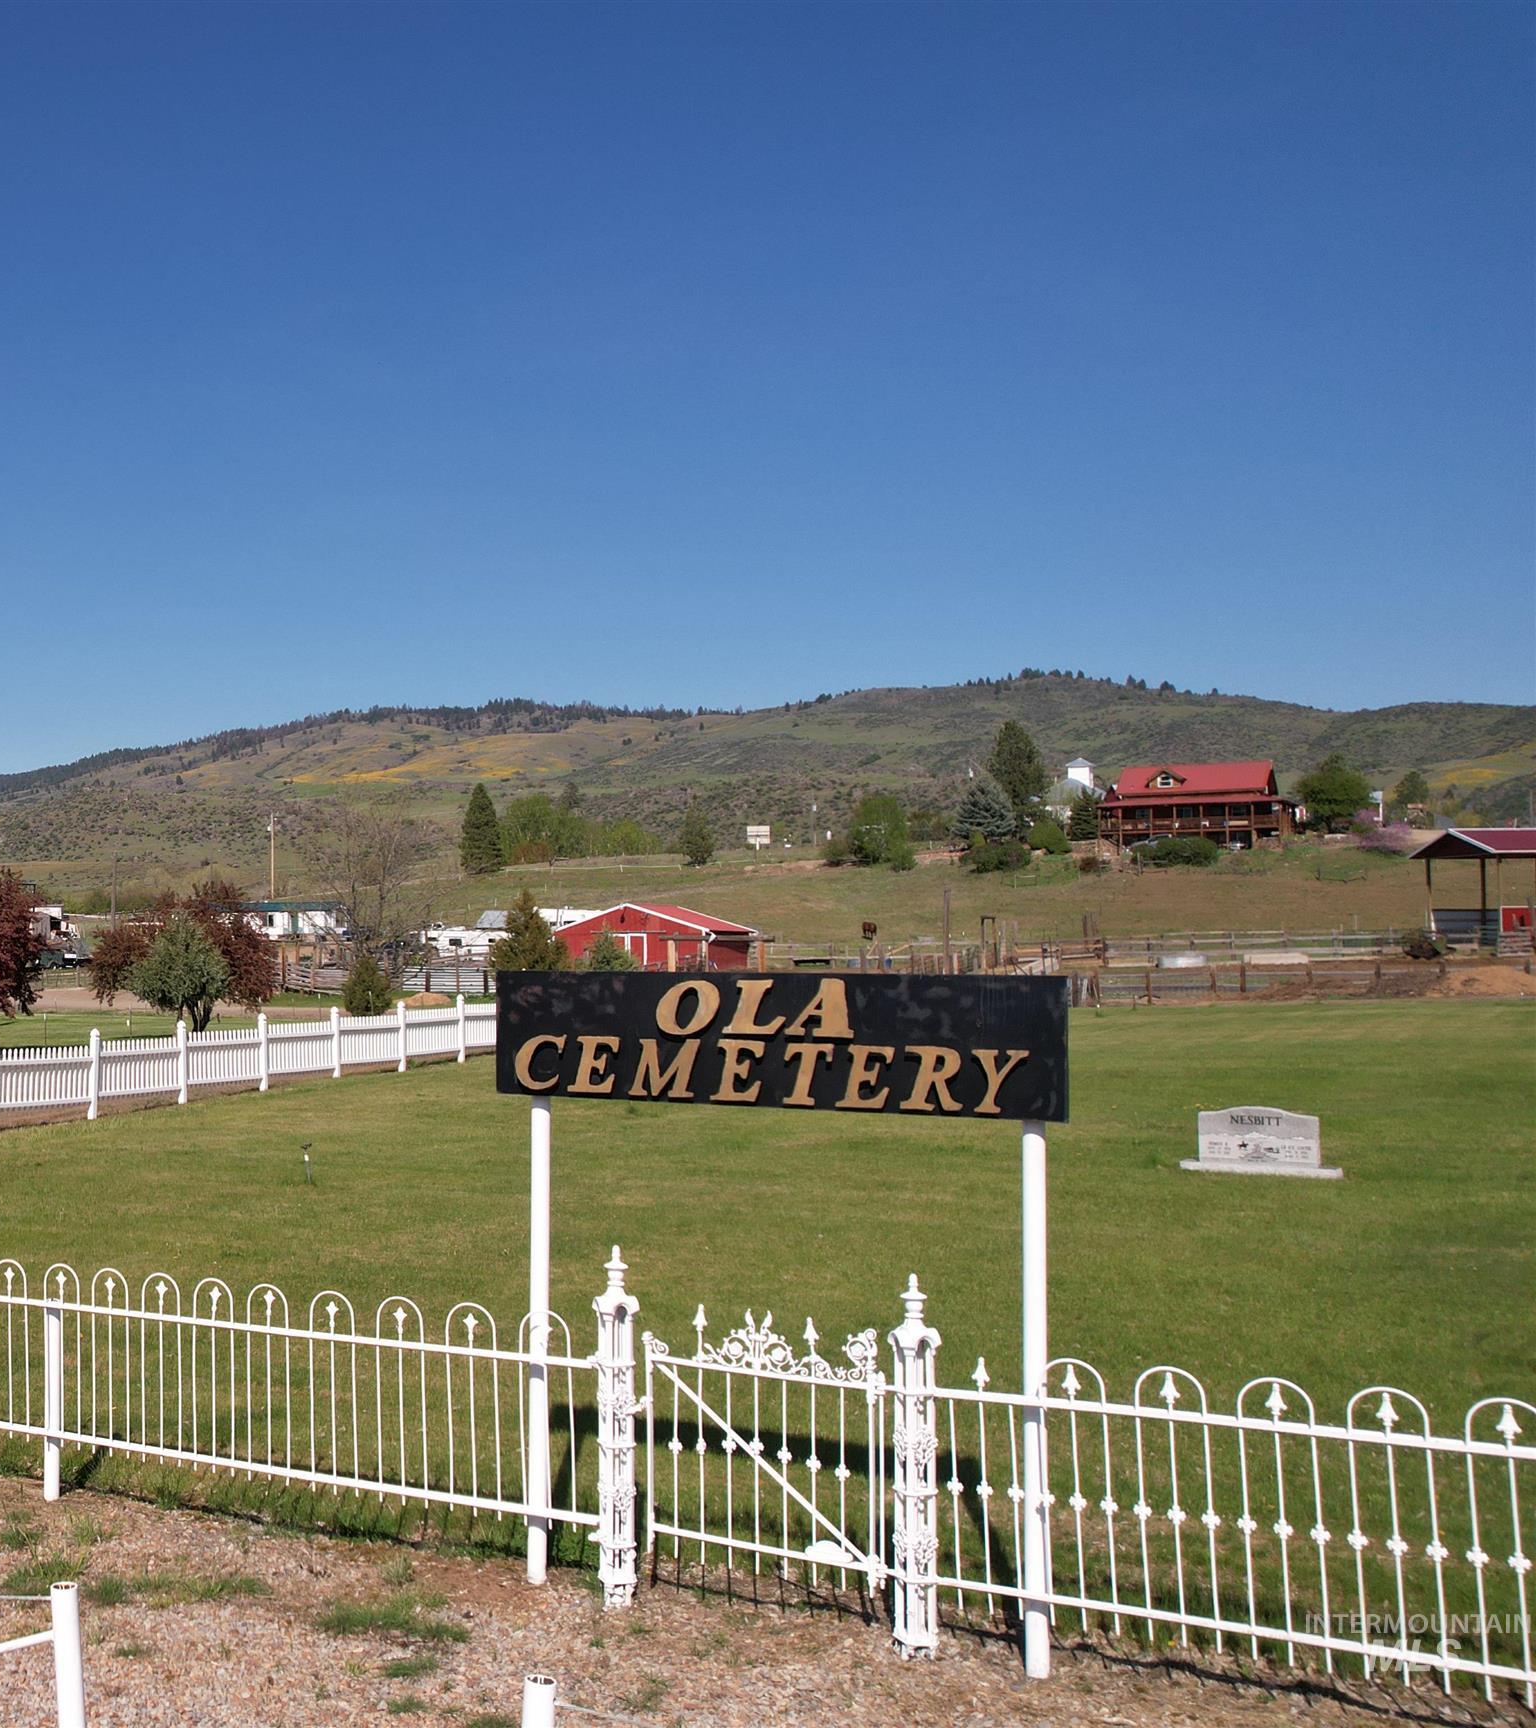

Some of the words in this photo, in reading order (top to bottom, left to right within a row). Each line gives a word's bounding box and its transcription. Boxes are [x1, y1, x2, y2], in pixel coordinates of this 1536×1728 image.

[656, 978, 855, 1039] OLA
[514, 1033, 1031, 1115] CEMETERY
[1230, 1114, 1282, 1127] NESBITT
